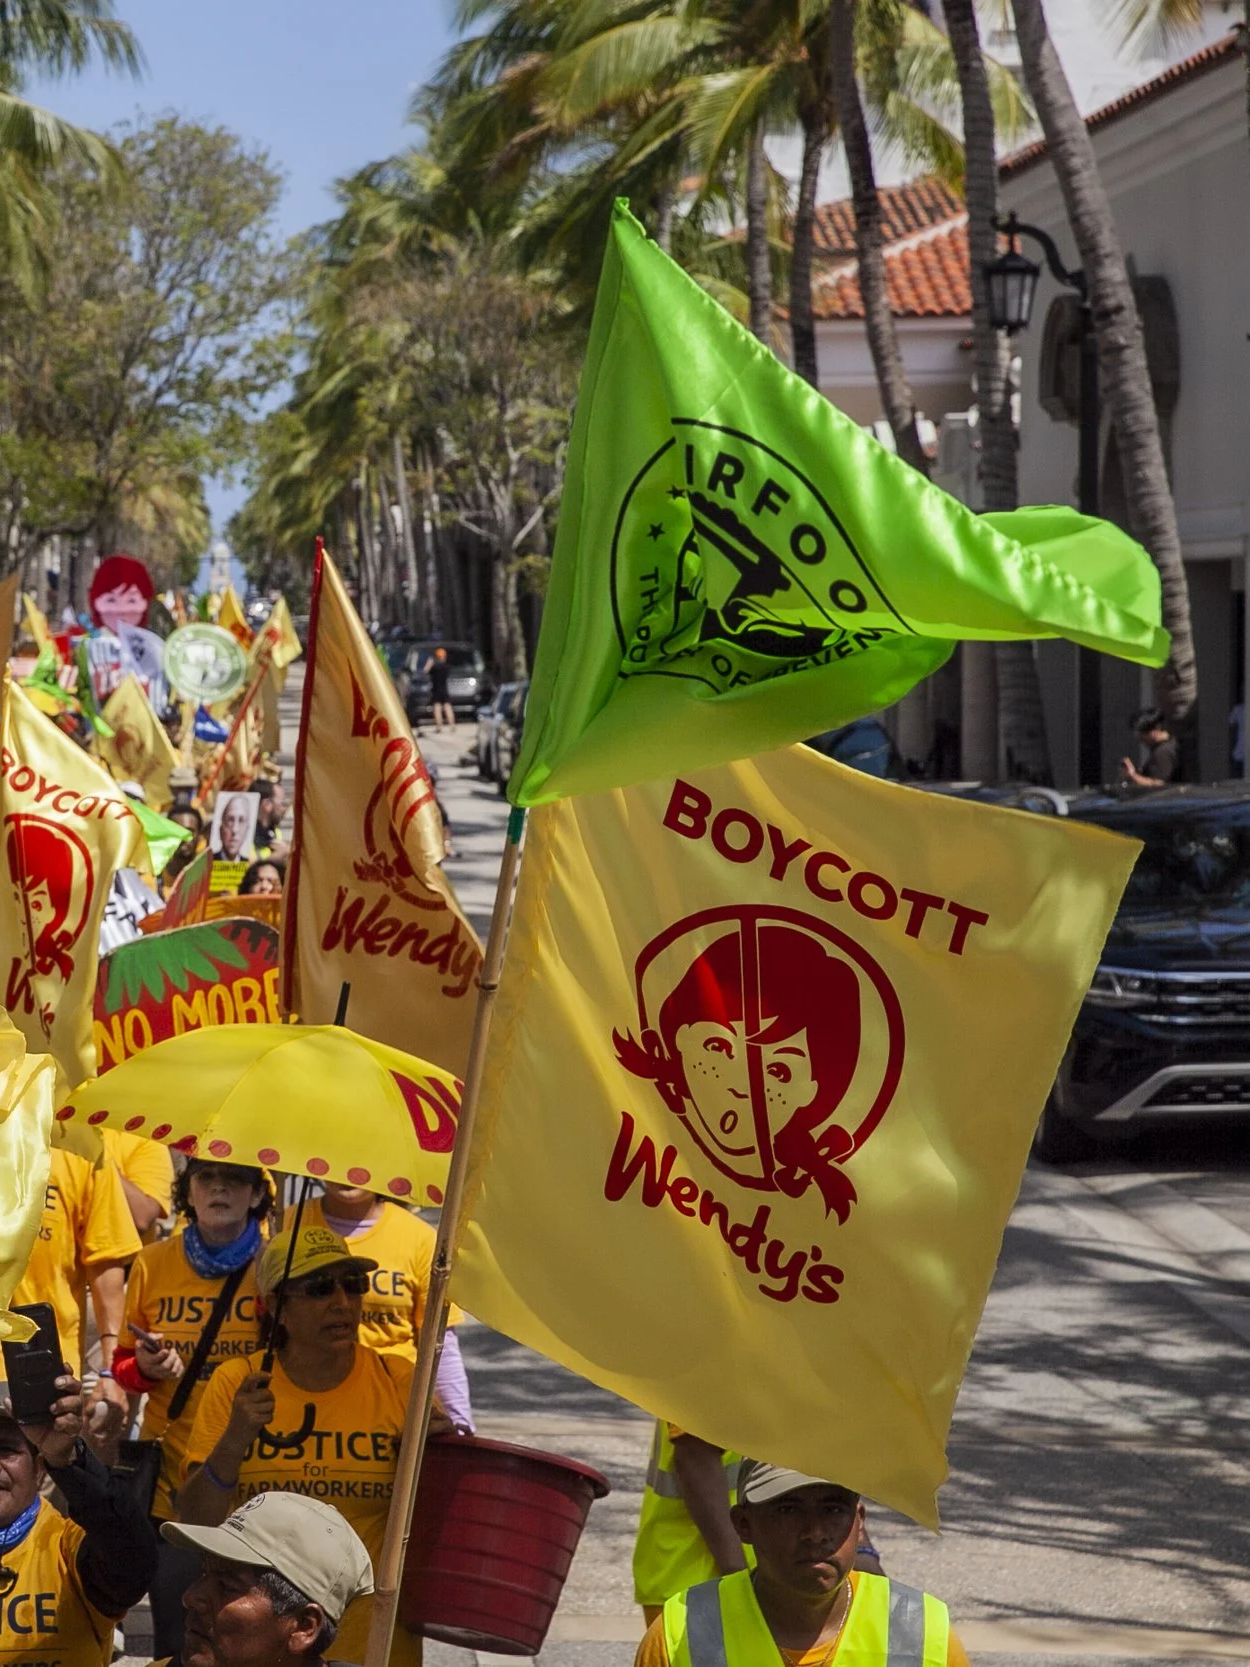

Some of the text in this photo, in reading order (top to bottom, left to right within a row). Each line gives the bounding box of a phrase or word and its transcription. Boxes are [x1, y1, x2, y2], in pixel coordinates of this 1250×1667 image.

[710, 654, 753, 689] OF
[662, 778, 989, 956] BOYCOTT
[94, 1008, 153, 1067] NO
[603, 1110, 845, 1304] Wendy's
[302, 1461, 330, 1477] for
